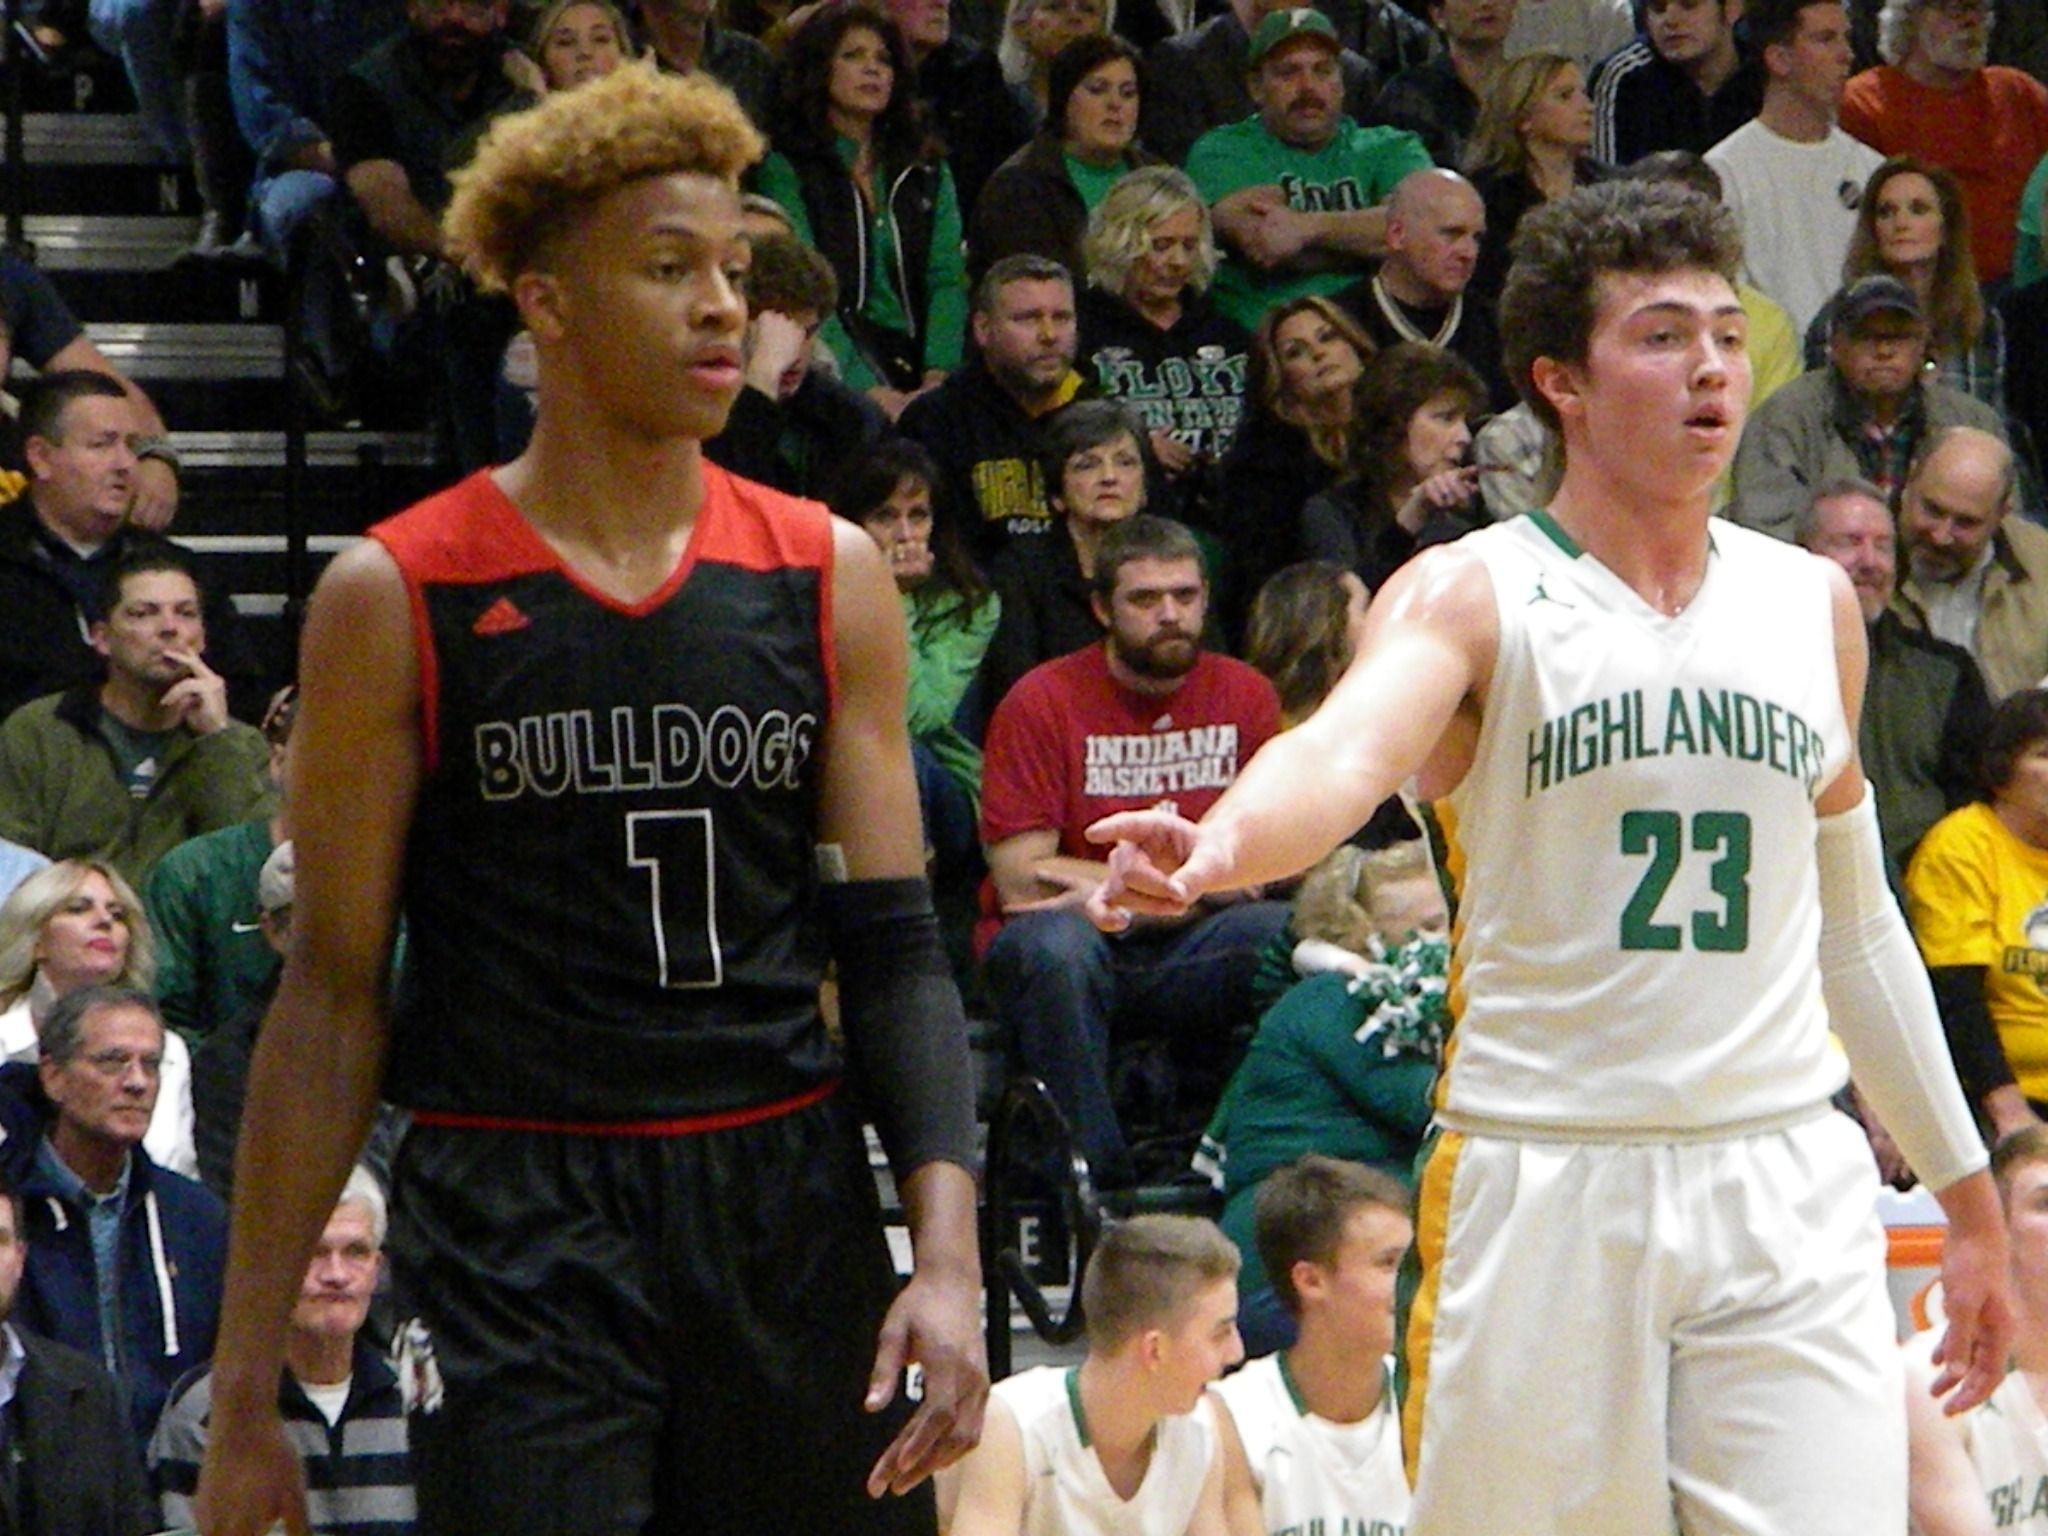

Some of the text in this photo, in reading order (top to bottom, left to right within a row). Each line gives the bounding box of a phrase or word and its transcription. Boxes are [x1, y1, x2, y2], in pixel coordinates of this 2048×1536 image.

[1083, 756, 1238, 797] BASKETBALL
[1084, 723, 1239, 766] INDIANA
[1525, 687, 1825, 800] HIGHLANDERS
[625, 808, 723, 988] 1
[1619, 810, 1752, 953] 23
[1019, 1216, 1042, 1266] E
